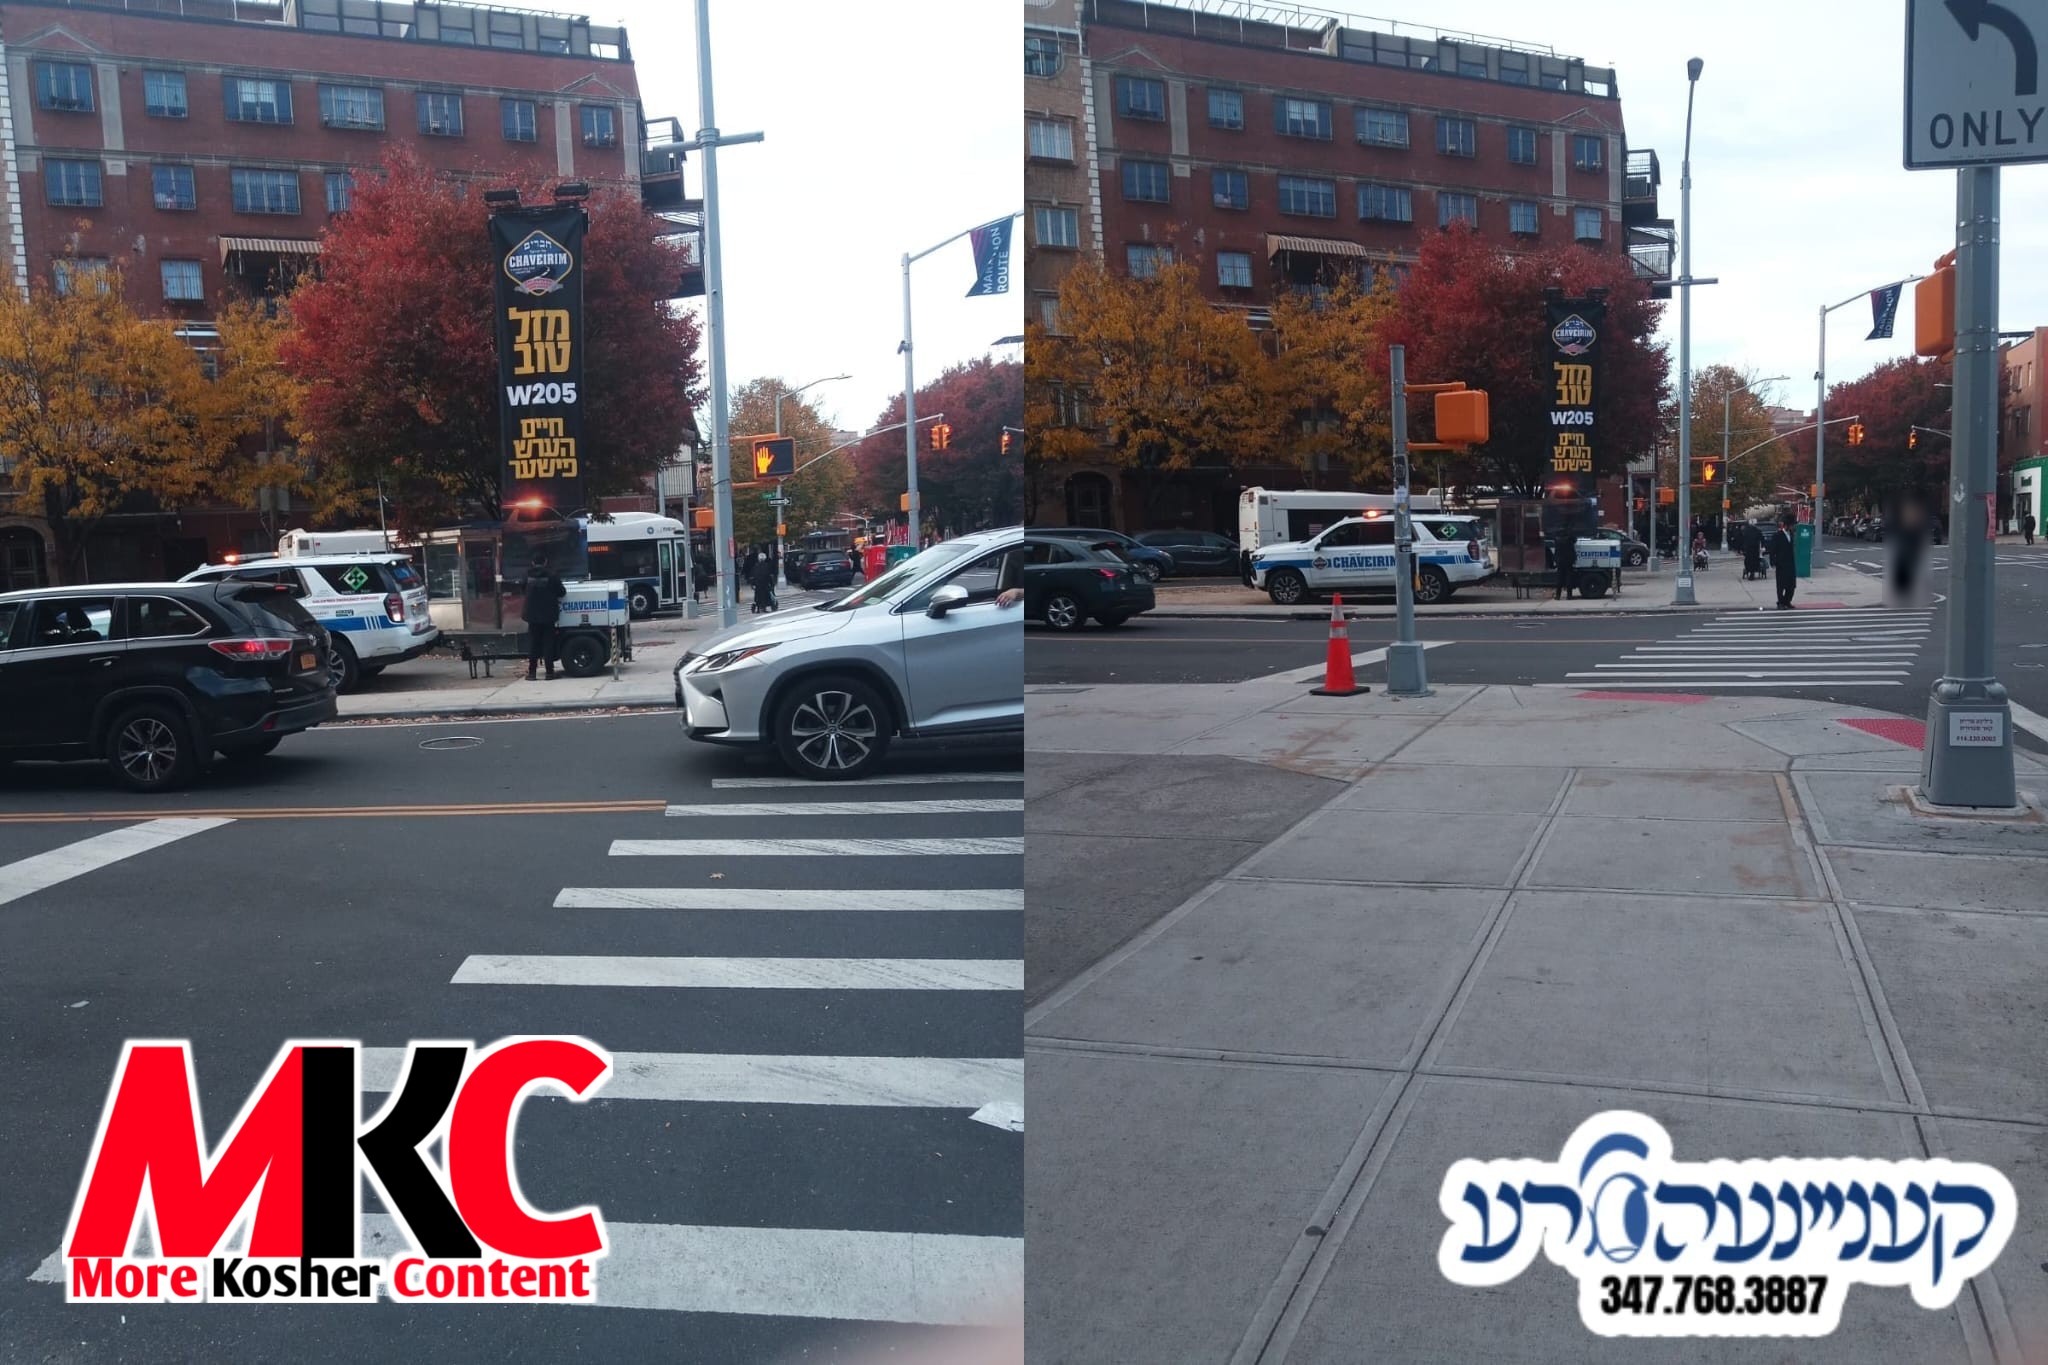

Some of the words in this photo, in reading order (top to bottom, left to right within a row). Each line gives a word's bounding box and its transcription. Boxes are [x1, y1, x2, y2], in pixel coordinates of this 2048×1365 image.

[1929, 107, 2045, 149] ONLY
[523, 239, 552, 250] חברים
[508, 253, 568, 268] CHAVEIRIM
[996, 250, 1009, 292] ROUTE
[508, 306, 571, 342] מזל
[513, 341, 572, 375] טוב
[1553, 361, 1593, 385] מזל
[506, 382, 578, 407] W205
[1555, 384, 1593, 405] טוב
[520, 417, 564, 439] חיים
[1550, 410, 1594, 425] W205
[513, 437, 576, 459] הערש
[1558, 432, 1585, 446] חיים
[508, 458, 578, 480] פישער
[562, 600, 608, 611] CHAVEIRIM
